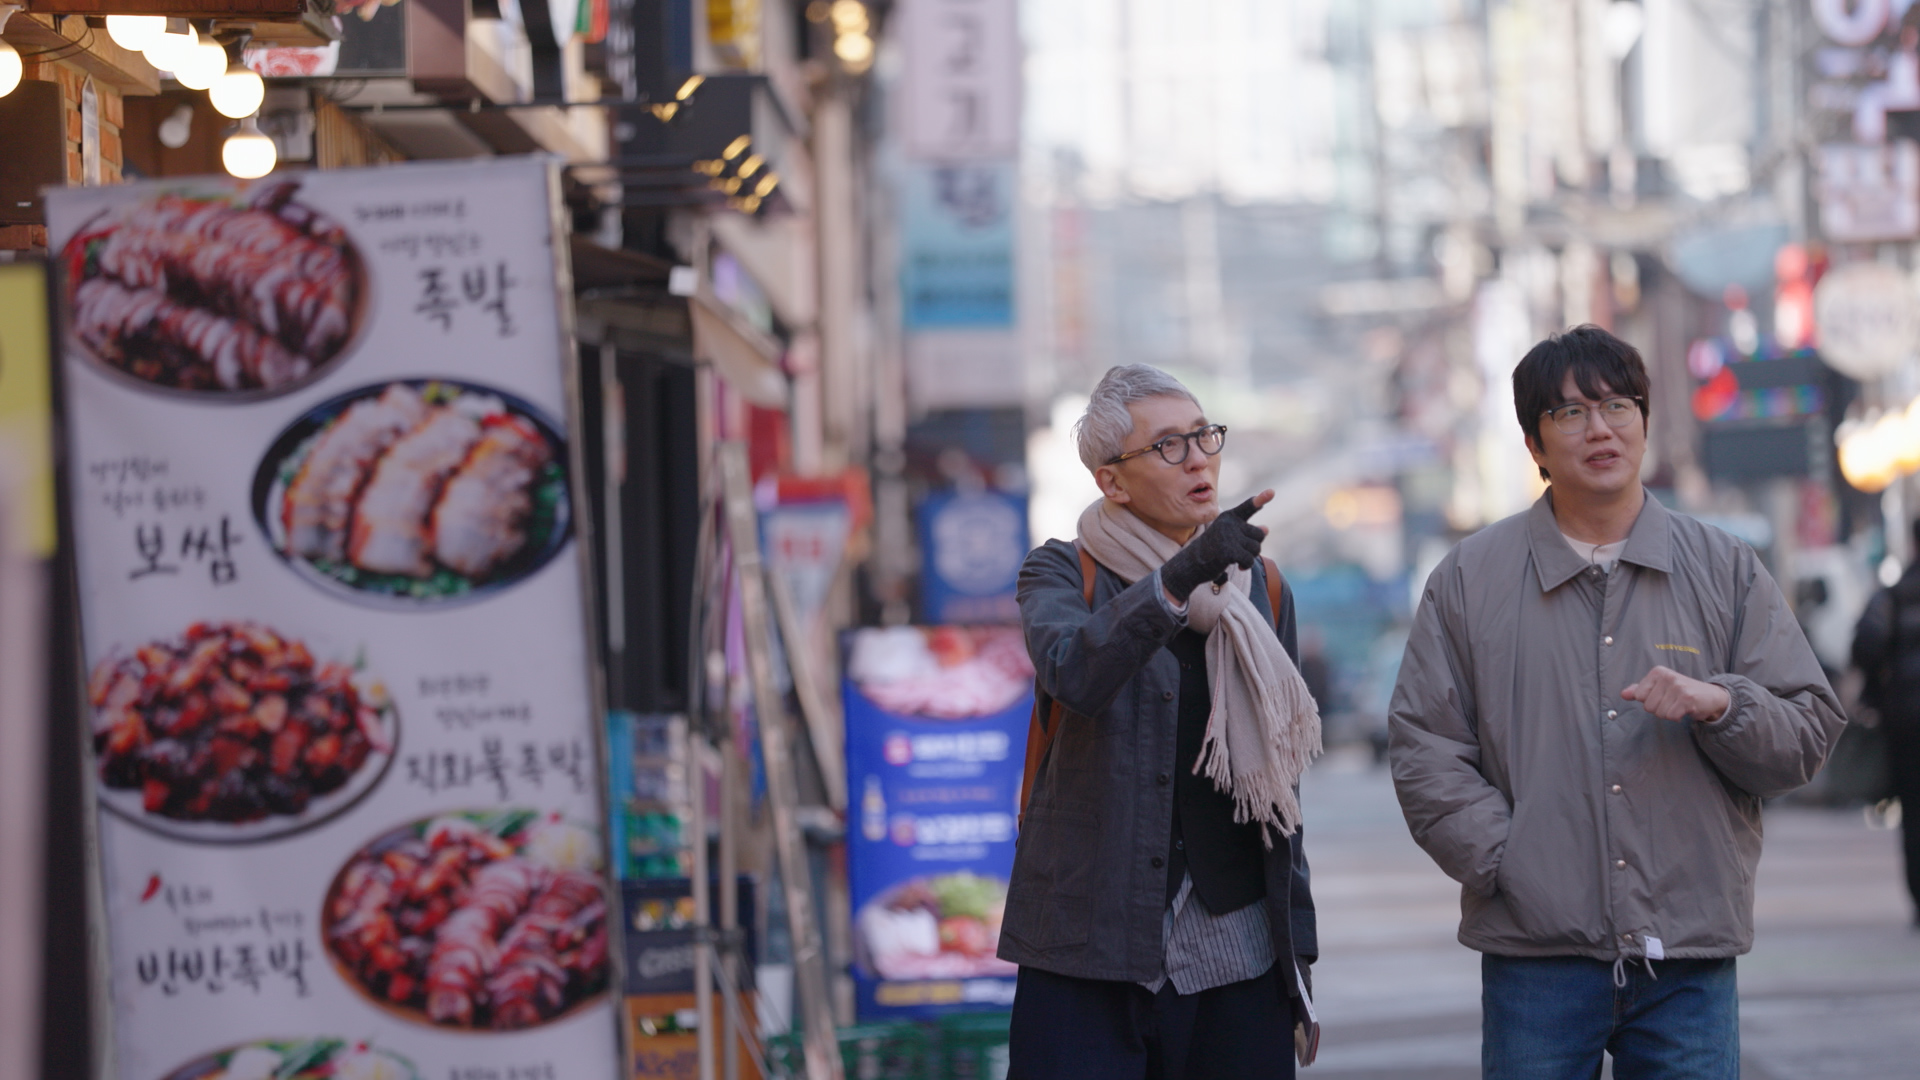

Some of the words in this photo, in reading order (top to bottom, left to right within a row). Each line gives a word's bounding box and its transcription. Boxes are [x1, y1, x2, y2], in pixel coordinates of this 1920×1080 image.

[414, 262, 519, 338] 족발
[128, 514, 244, 588] 보쌈
[136, 938, 312, 998] 반반족발
